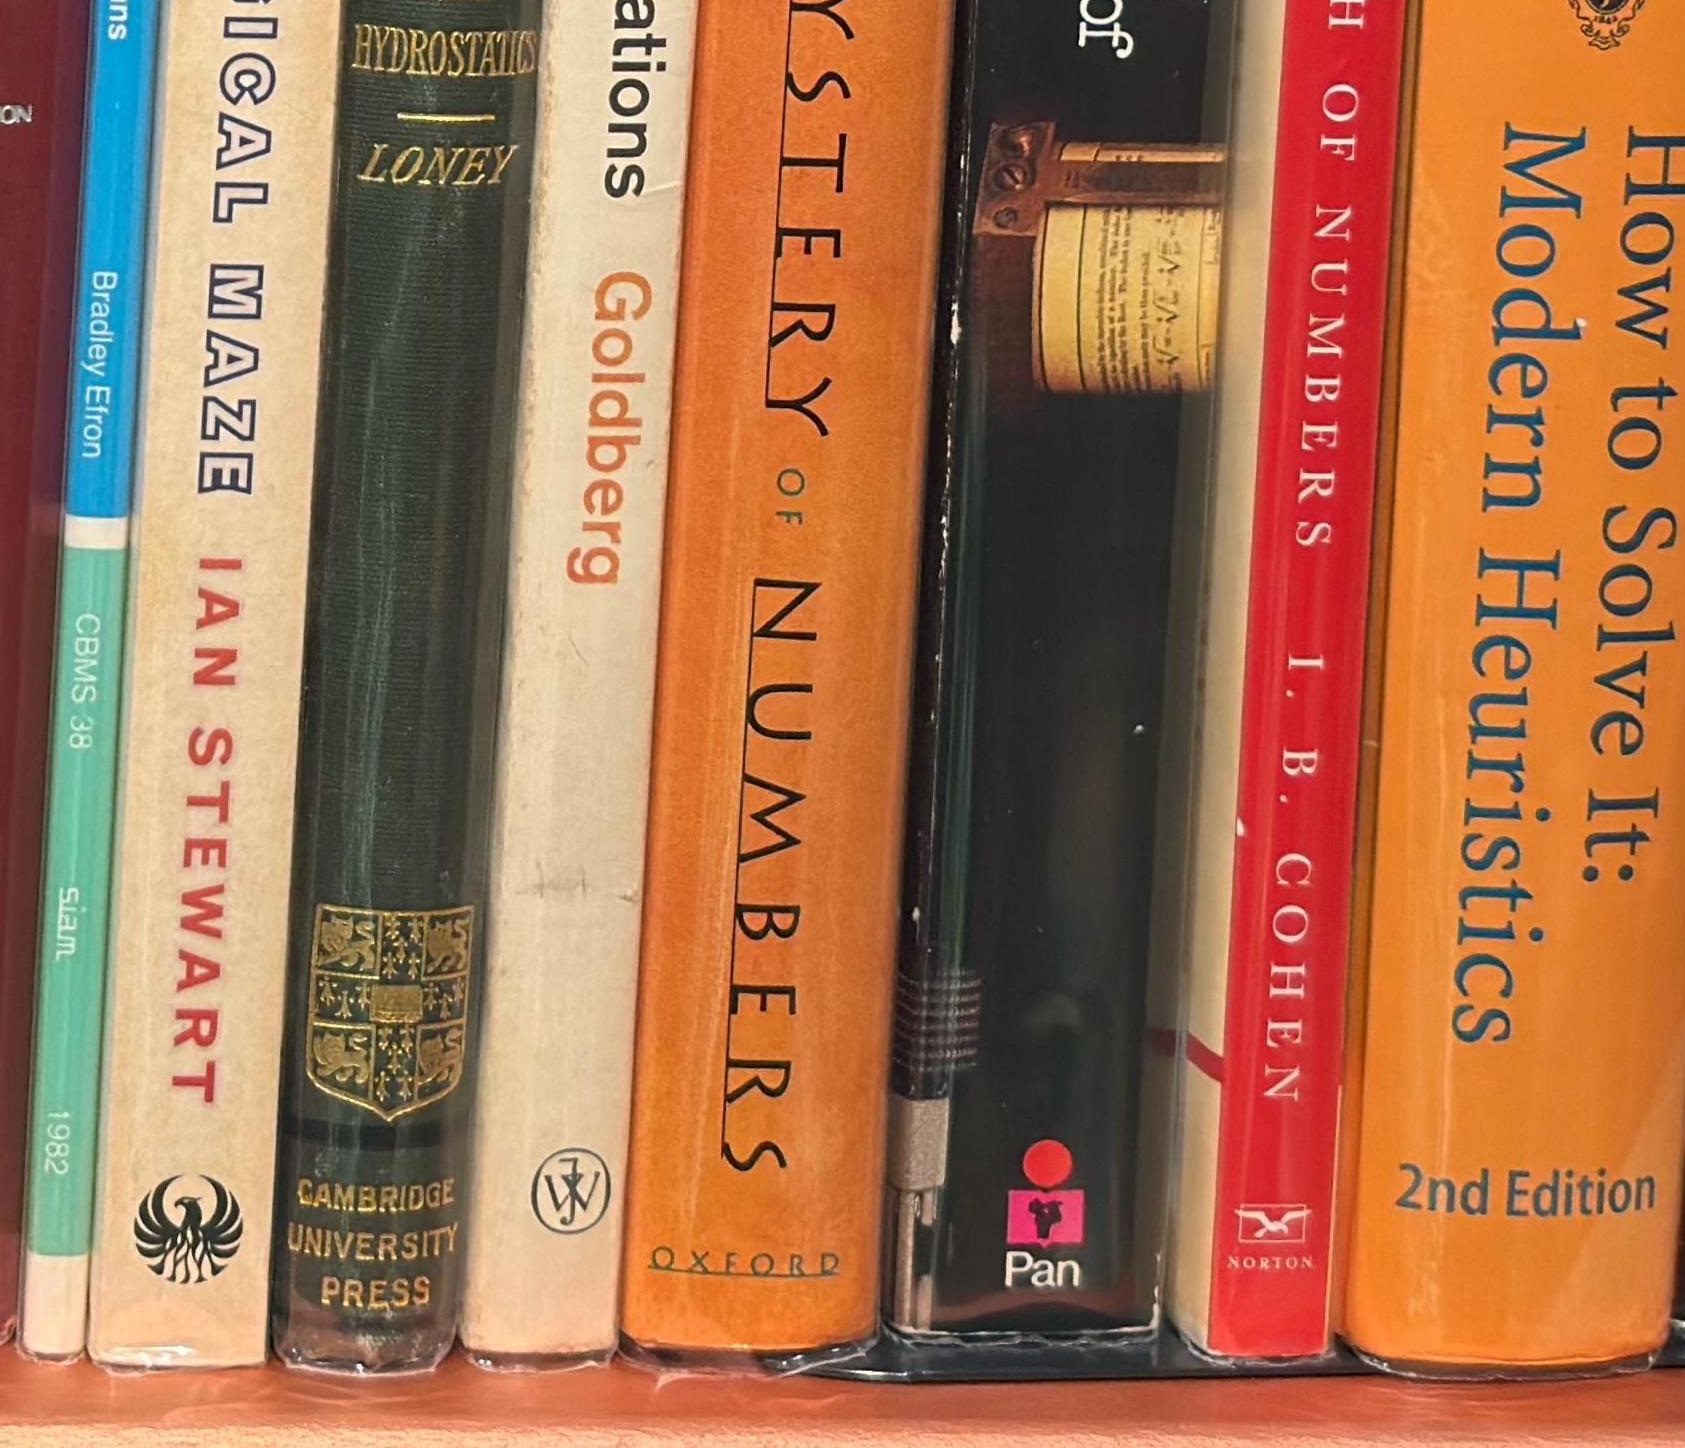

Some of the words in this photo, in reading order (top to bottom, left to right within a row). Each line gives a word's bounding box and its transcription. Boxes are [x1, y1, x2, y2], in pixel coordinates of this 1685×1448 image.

[1321, 84, 1358, 160] OF
[357, 144, 520, 186] LONEY
[82, 272, 118, 376] Bradley
[1482, 122, 1587, 512] Modern
[198, 264, 264, 494] MAZE
[1296, 205, 1351, 545] NUMBERS
[82, 386, 110, 457] Efron
[567, 272, 654, 584] Goldberg
[1608, 378, 1678, 470] to
[776, 468, 805, 525] OF
[72, 614, 100, 703] CBMS
[193, 559, 242, 686] IAN
[1591, 505, 1677, 755] Solve
[1287, 656, 1324, 696] I.
[69, 716, 93, 749] 38
[1280, 748, 1318, 802] B.
[1452, 547, 1561, 1043] Heuristics
[1583, 788, 1659, 882] It:
[721, 578, 821, 1171] NUMBERS
[56, 888, 79, 961] siam
[172, 727, 233, 1104] STEWART
[1264, 854, 1312, 1101] COHEN
[44, 1112, 70, 1175] 1982
[297, 1178, 454, 1214] CAMBRIDGE
[1396, 1163, 1489, 1215] 2nd
[1507, 1168, 1655, 1217] Edition
[288, 1222, 458, 1261] UNIVERSITY
[648, 1246, 840, 1280] OXFORD
[1005, 1251, 1080, 1287] Pan
[1228, 1256, 1312, 1270] NORTON
[321, 1277, 429, 1311] PRESS
